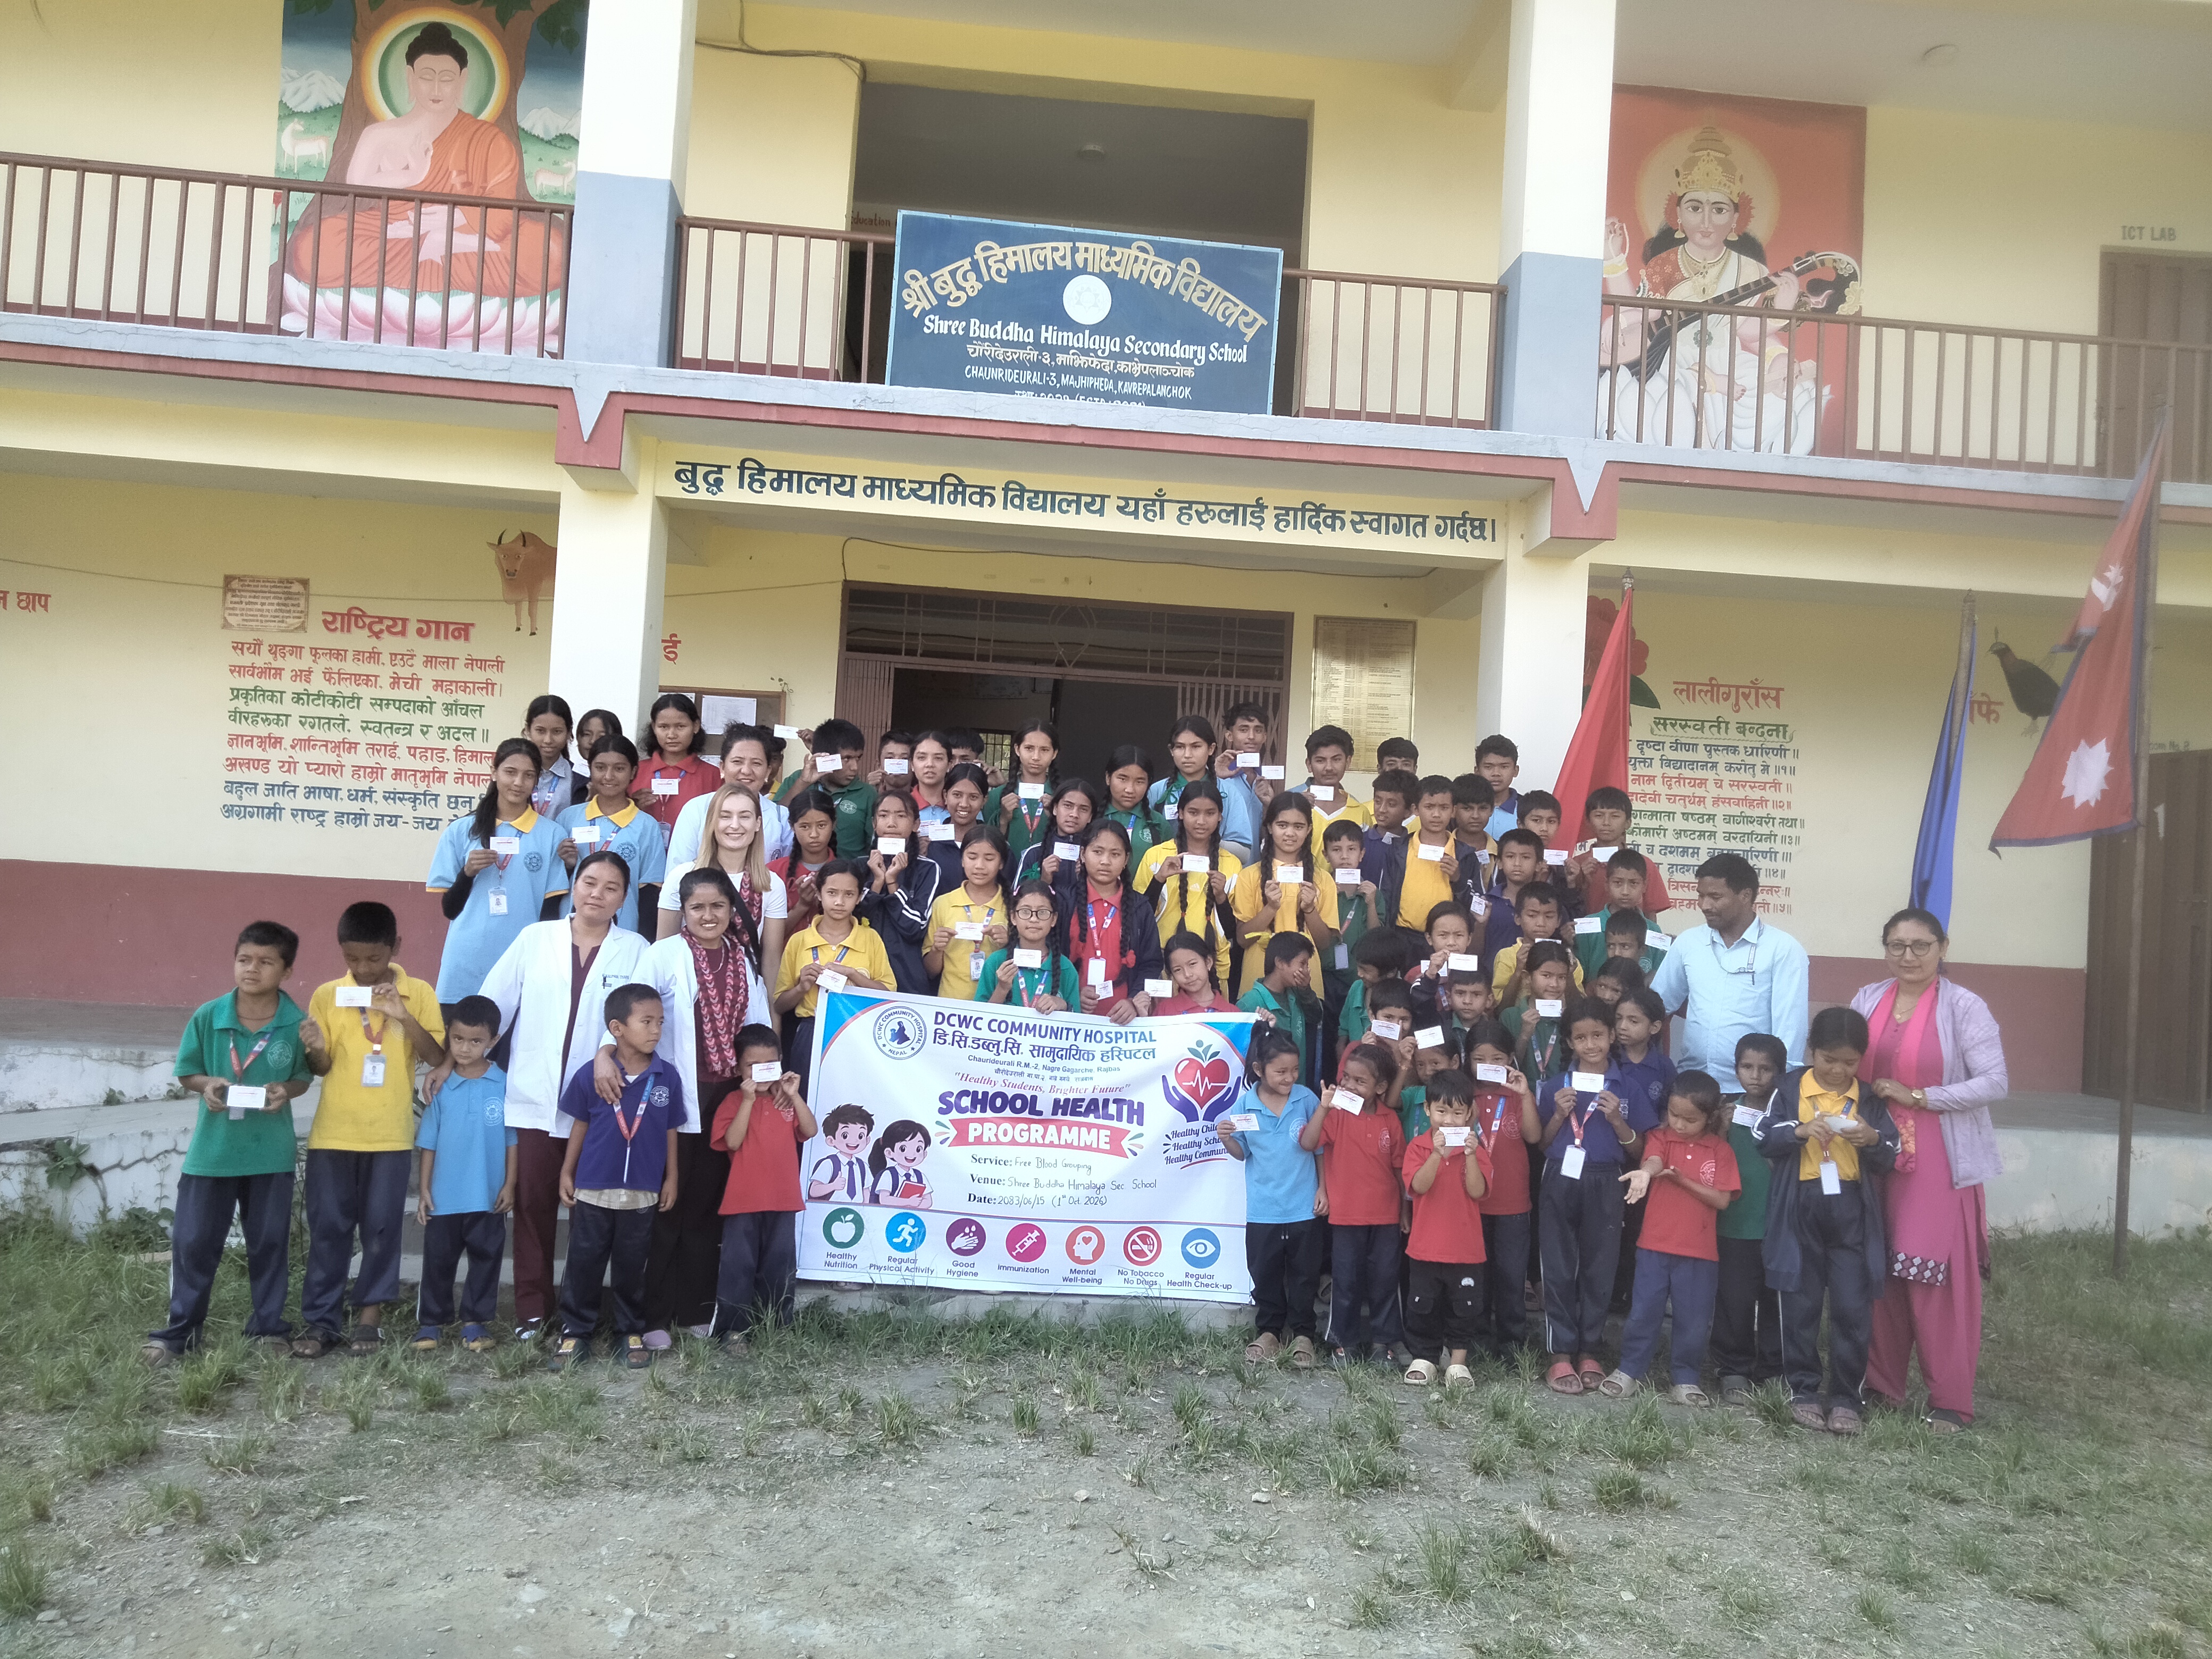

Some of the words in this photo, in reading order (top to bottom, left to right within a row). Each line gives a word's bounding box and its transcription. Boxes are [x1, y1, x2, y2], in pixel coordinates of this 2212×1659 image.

[2121, 225, 2145, 240] ICT
[2150, 227, 2176, 241] LAB
[902, 270, 937, 318] श्री
[931, 256, 981, 307] बुद्ध
[975, 240, 1073, 283] हिमालय
[1075, 241, 1175, 290] माध्यमिक
[1169, 257, 1268, 342] विद्यालय
[923, 315, 966, 336] Shree
[969, 318, 1034, 343] Buddha
[1040, 324, 1120, 356] Himalaya
[1124, 335, 1205, 365] Secondary
[1208, 343, 1247, 364] School
[675, 460, 730, 496] बुद्ध
[737, 457, 857, 498] हिमालय
[862, 473, 995, 508] माध्यमिक
[1002, 480, 1110, 517] विद्यालय
[1116, 488, 1170, 521] यहाँ
[1273, 501, 1346, 534] हार्दिक
[1350, 510, 1428, 539] स्वागत
[16, 591, 52, 613] छाप
[322, 607, 409, 640] राष्ट्रिय
[415, 618, 475, 642] गान
[309, 647, 349, 665] फूलका
[423, 655, 459, 671] माला
[464, 653, 506, 674] नेपाली
[229, 663, 285, 681] सार्वभौम
[290, 667, 314, 685] भई
[389, 672, 422, 691] मेची
[229, 685, 286, 706] प्रकृतिका
[291, 689, 363, 710] कोटीकोटी
[370, 696, 436, 715] सम्पदाको
[441, 698, 485, 718] आँचल
[1673, 677, 1784, 713] लालीगुराँस
[360, 720, 414, 738] स्वतन्त्र
[420, 724, 433, 740] र
[437, 726, 476, 742] अटल
[1653, 716, 1730, 736] सरस्वती
[1669, 739, 1699, 754] वीणा
[1703, 743, 1740, 759] पुस्तक
[1743, 743, 1790, 759] धारिणी
[223, 757, 271, 773] अखण्ड
[278, 756, 299, 775] यो
[304, 760, 345, 779] प्यारो
[351, 762, 387, 783] हाम्रो
[391, 766, 448, 789] मातृभूमि
[1724, 759, 1756, 778] करोतु
[1760, 760, 1770, 775] मे
[1631, 774, 1657, 786] नाम
[1713, 778, 1724, 790] च
[1728, 778, 1782, 793] सरस्वती
[224, 781, 259, 801] बहुल
[263, 781, 299, 799] जाति
[382, 788, 440, 811] संस्कृति
[1712, 794, 1770, 811] हंसवाहिनी
[221, 802, 286, 822] अग्रगामी
[290, 808, 329, 827] राष्ट्र
[334, 808, 370, 828] हाम्रो
[1778, 817, 1797, 828] तथा
[1723, 830, 1778, 845] वरदायिनी
[1646, 844, 1655, 855] च
[882, 1010, 915, 1022] COMMUNITY
[914, 1018, 923, 1044] HOSPITAL
[934, 1011, 983, 1030] DCWC
[987, 1018, 1082, 1042] COMMUNITY
[1084, 1029, 1157, 1044] HOSPITAL
[1029, 1044, 1096, 1063] सामुदायिक
[968, 1055, 1015, 1067] Chaurideurali
[1042, 1064, 1060, 1073] Nagre
[1049, 1085, 1088, 1095] Brighter
[937, 1089, 1043, 1116] SCHOOL
[1051, 1097, 1144, 1126] HEALTH
[968, 1122, 1111, 1150] PROGRAMME
[1171, 1128, 1200, 1139] Healthy
[1172, 1140, 1202, 1151] Healthy
[1204, 1136, 1221, 1146] Scho
[971, 1154, 1012, 1166] Service:
[1015, 1157, 1031, 1167] Free
[1036, 1157, 1057, 1168] Blood
[1062, 1159, 1092, 1175] Grouping
[1164, 1154, 1193, 1164] Healthy
[1194, 1147, 1229, 1159] Commun
[970, 1174, 1006, 1185] Venue:
[1008, 1176, 1030, 1187] Shree
[1034, 1177, 1064, 1188] Buddha
[1068, 1179, 1105, 1195] Himalaya
[1132, 1179, 1157, 1189] School
[967, 1193, 996, 1204] Date:
[998, 1194, 1045, 1209] 2083/06/15
[1084, 1196, 1107, 1206] 2026)
[824, 1260, 858, 1270] Nutrition
[826, 1251, 857, 1262] Healthy
[887, 1255, 918, 1264] Regular
[869, 1263, 902, 1273] Physical
[904, 1266, 935, 1275] Activity
[946, 1269, 979, 1277] Hygiene
[1130, 1269, 1164, 1278] Tobacco
[1185, 1271, 1214, 1280] Regular
[1062, 1276, 1102, 1285] Well-being
[1136, 1278, 1158, 1287] Drugs
[1167, 1279, 1192, 1288] Health
[1194, 1281, 1233, 1291] Check-up
